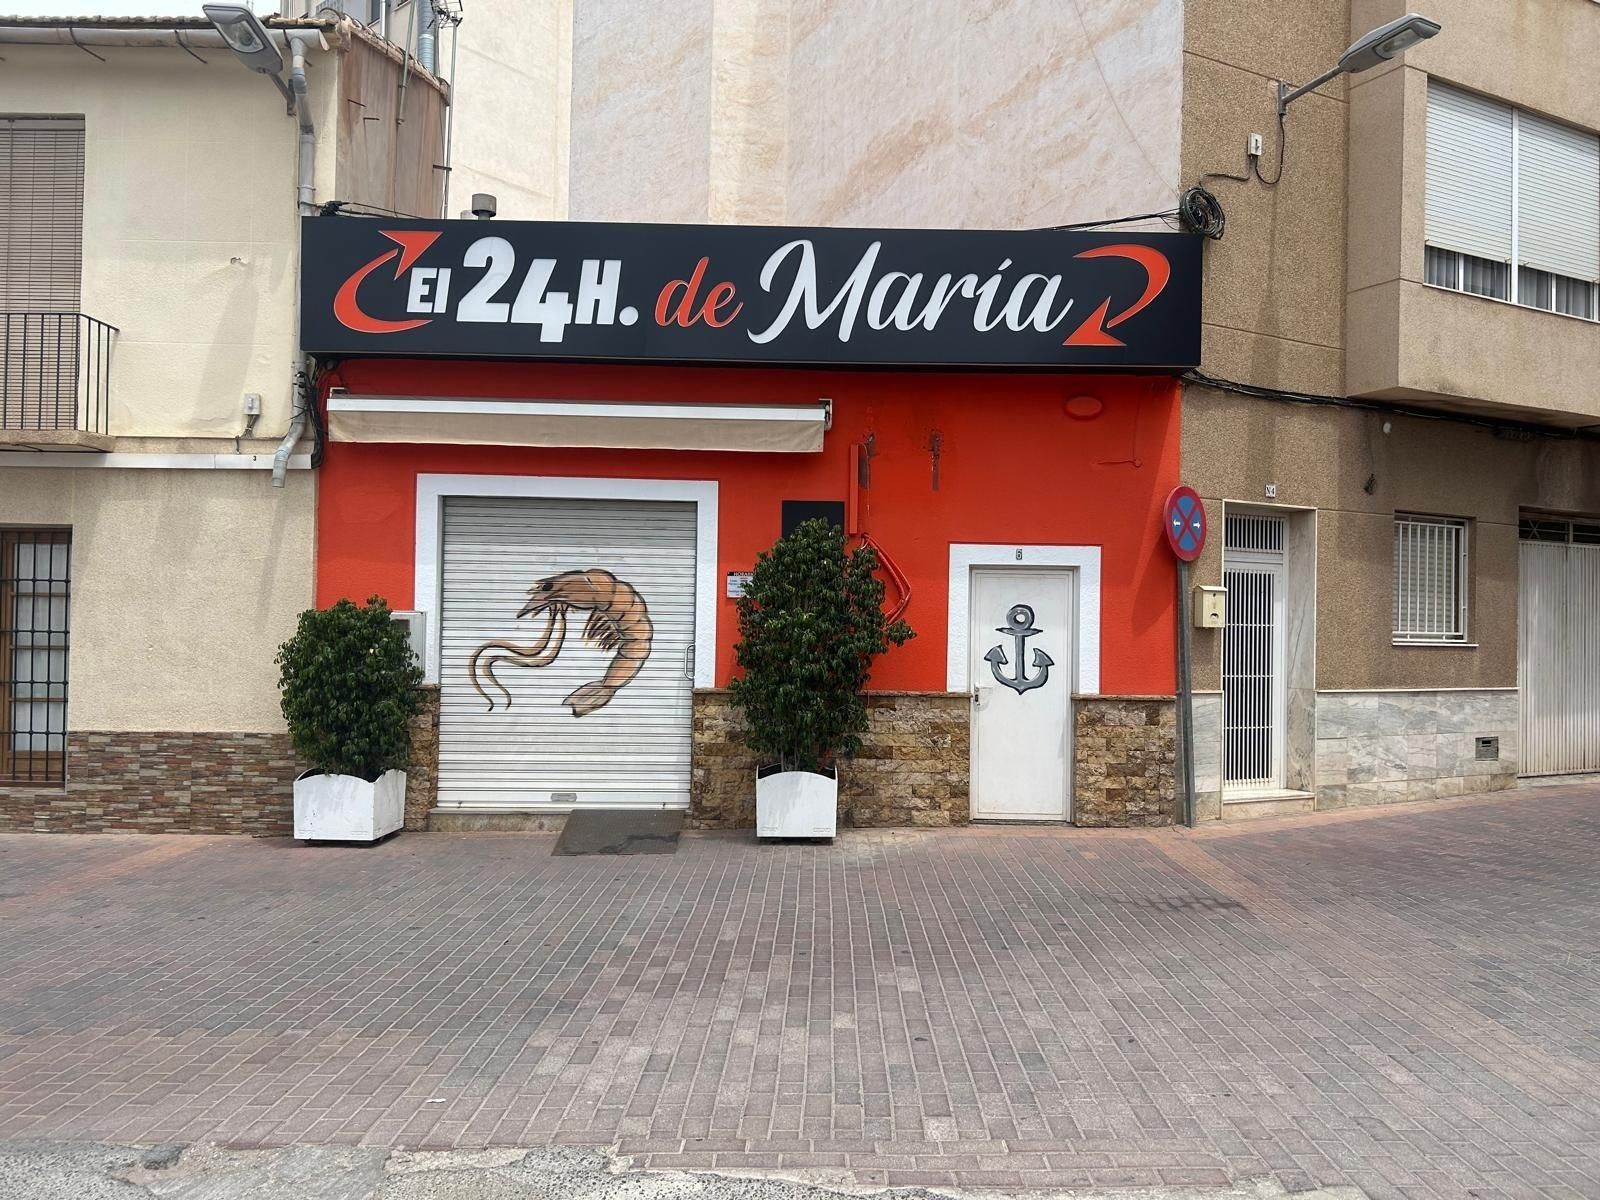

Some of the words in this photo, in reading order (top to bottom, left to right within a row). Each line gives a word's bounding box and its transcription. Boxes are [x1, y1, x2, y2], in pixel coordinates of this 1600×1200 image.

[406, 268, 451, 314] El
[456, 237, 639, 342] 24H.
[655, 256, 744, 328] de
[747, 240, 1073, 343] María
[1015, 548, 1023, 560] 6
